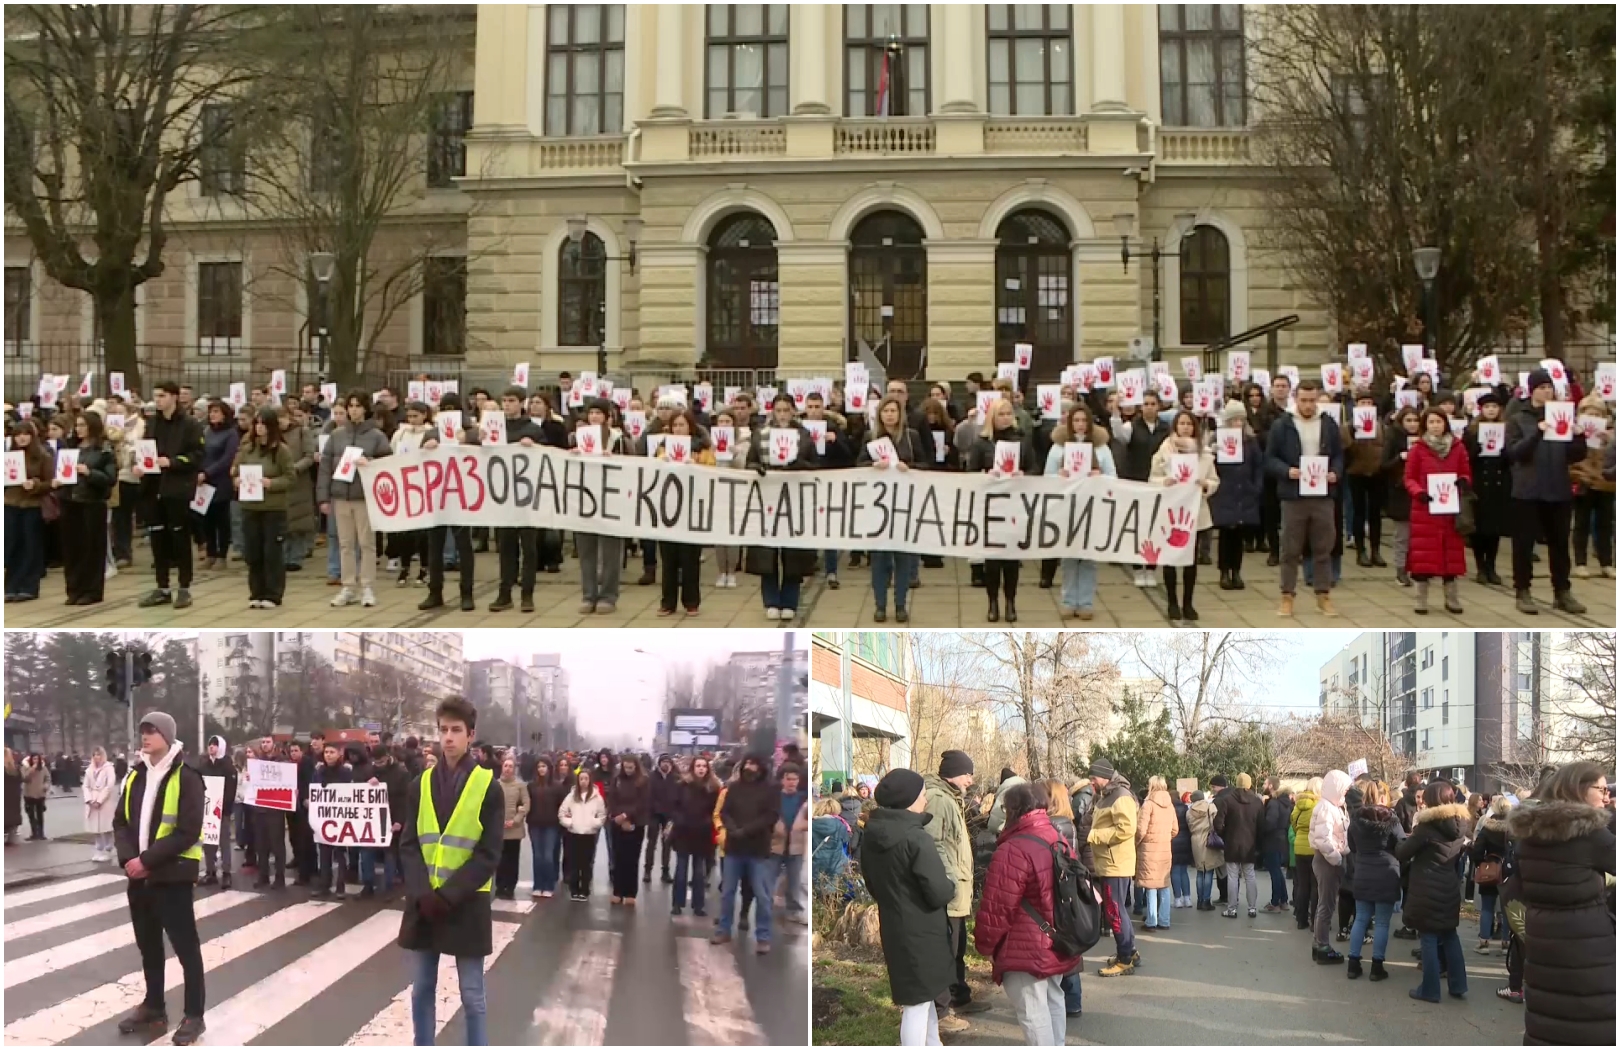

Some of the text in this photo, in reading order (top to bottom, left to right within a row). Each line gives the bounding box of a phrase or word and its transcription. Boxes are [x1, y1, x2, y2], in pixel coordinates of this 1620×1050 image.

[635, 467, 767, 537] КОШТА
[825, 480, 1011, 549] НЕЗНАЊЕ
[310, 788, 337, 803] БИТИ
[353, 788, 366, 804] НЕ
[317, 805, 375, 820] ПИТАЊЕ ЈЕ
